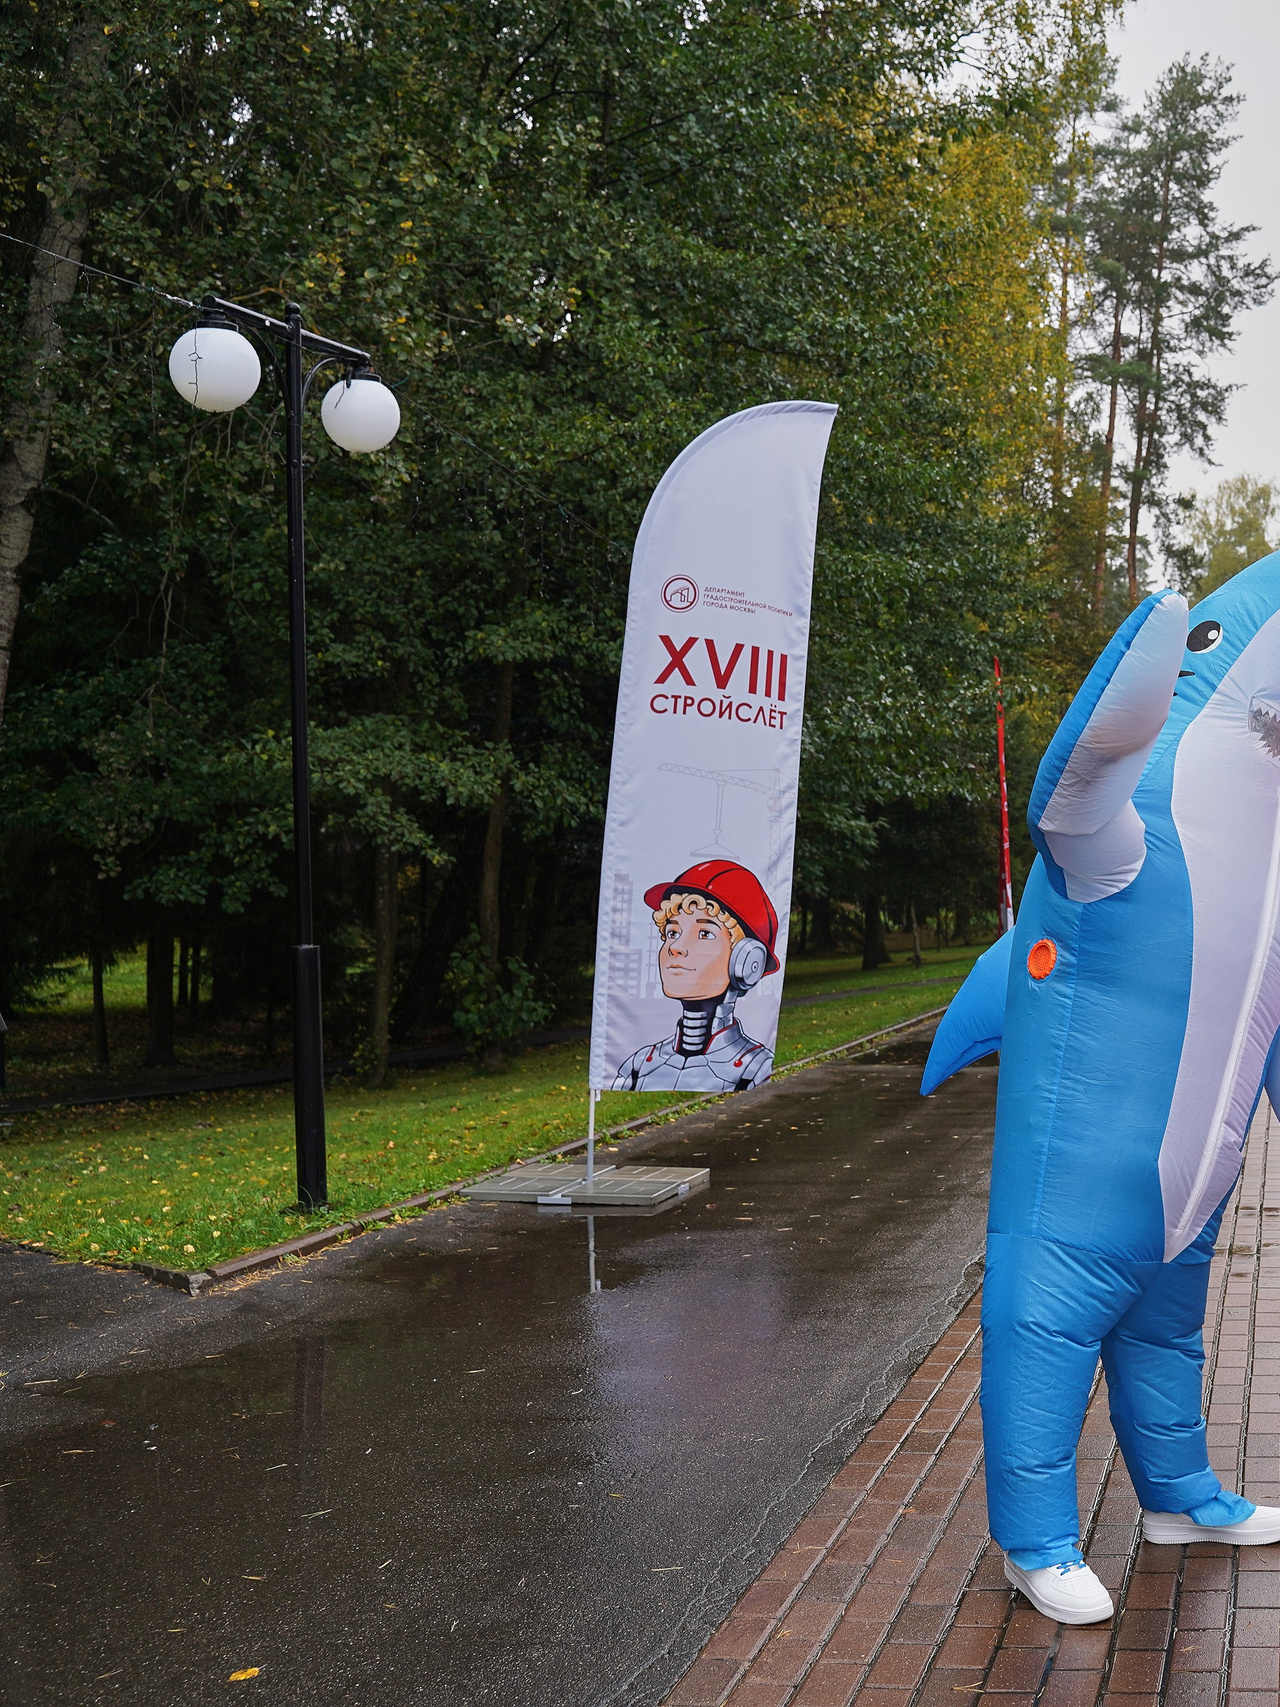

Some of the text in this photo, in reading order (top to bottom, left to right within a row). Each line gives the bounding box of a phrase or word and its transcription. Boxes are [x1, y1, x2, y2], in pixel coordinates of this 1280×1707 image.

[704, 586, 745, 598] ДЕПАРТАМЕНТ
[703, 593, 793, 617] ГРАДОСТРОИТЕЛЬНОЙ ПОЛИТИКИ
[703, 600, 756, 614] ГОРОДА МОСКВЫ
[653, 634, 788, 702] XVIII
[649, 693, 788, 730] СТРОЙСЛЁТ
